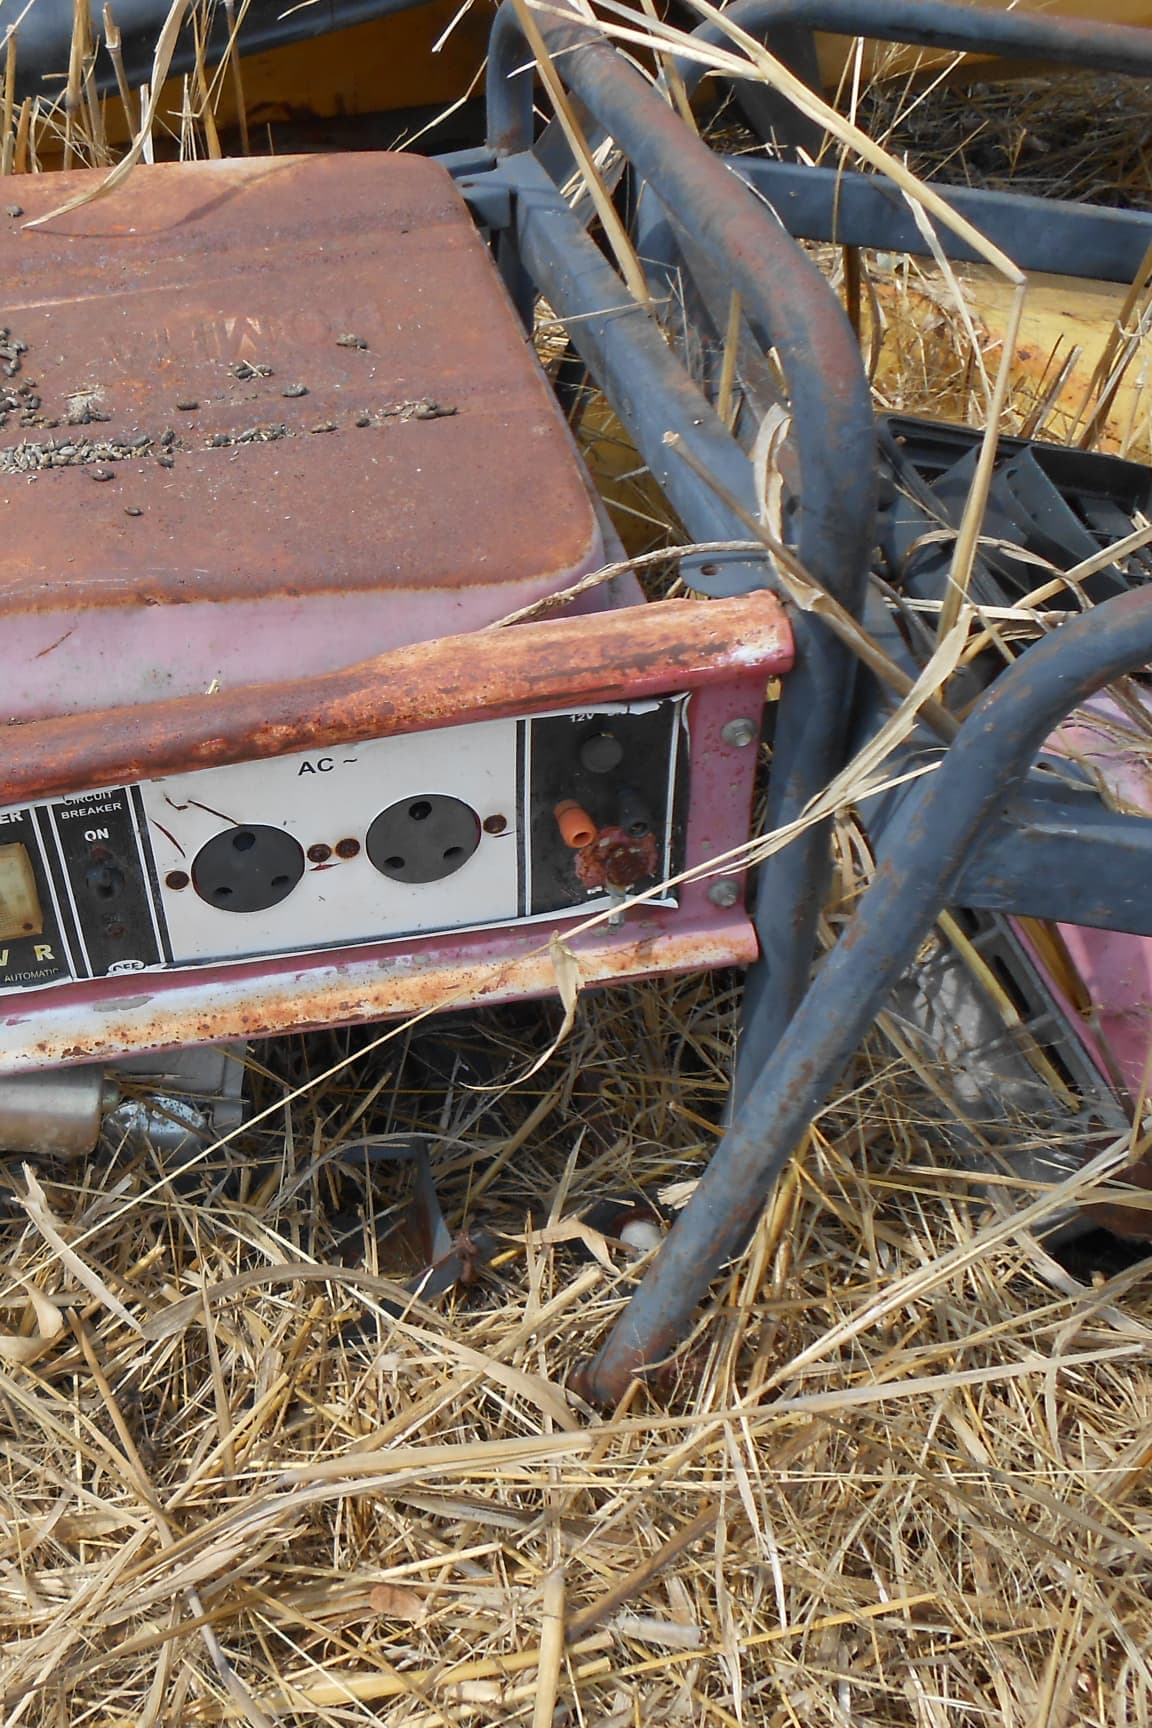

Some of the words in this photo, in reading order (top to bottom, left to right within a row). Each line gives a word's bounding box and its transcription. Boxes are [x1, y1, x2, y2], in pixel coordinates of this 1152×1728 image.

[297, 757, 335, 776] AC
[61, 802, 122, 819] BREAKER
[84, 827, 109, 842] ON
[4, 967, 60, 983] AUTOMATIC
